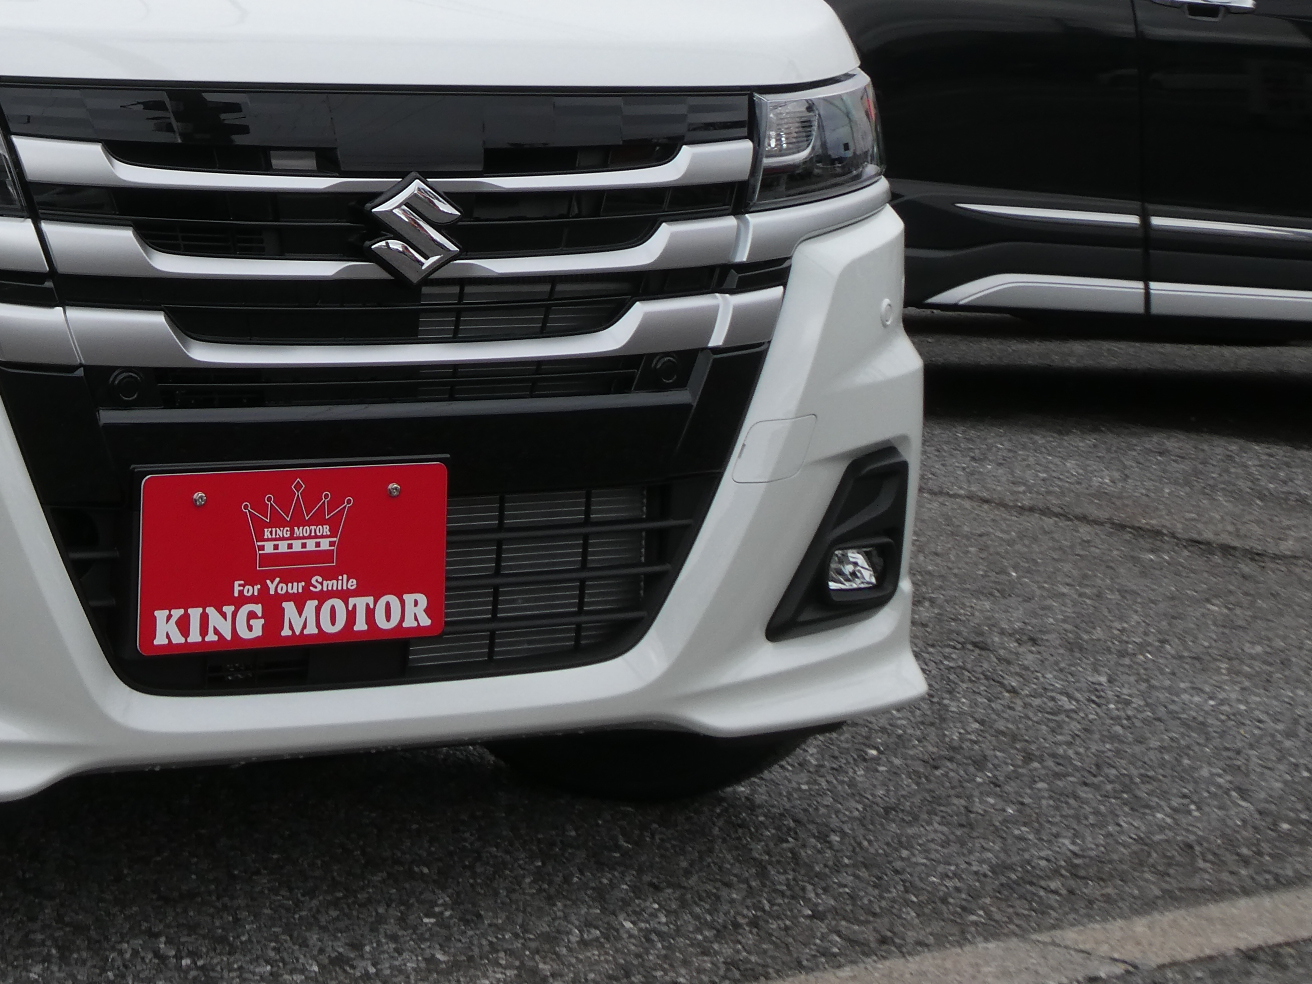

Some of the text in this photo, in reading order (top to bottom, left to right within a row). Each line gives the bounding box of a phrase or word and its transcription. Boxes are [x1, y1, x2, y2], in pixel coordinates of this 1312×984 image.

[263, 525, 331, 539] KING MOTOR
[234, 574, 358, 597] For Your Smile
[153, 593, 432, 645] KING MOTOR
